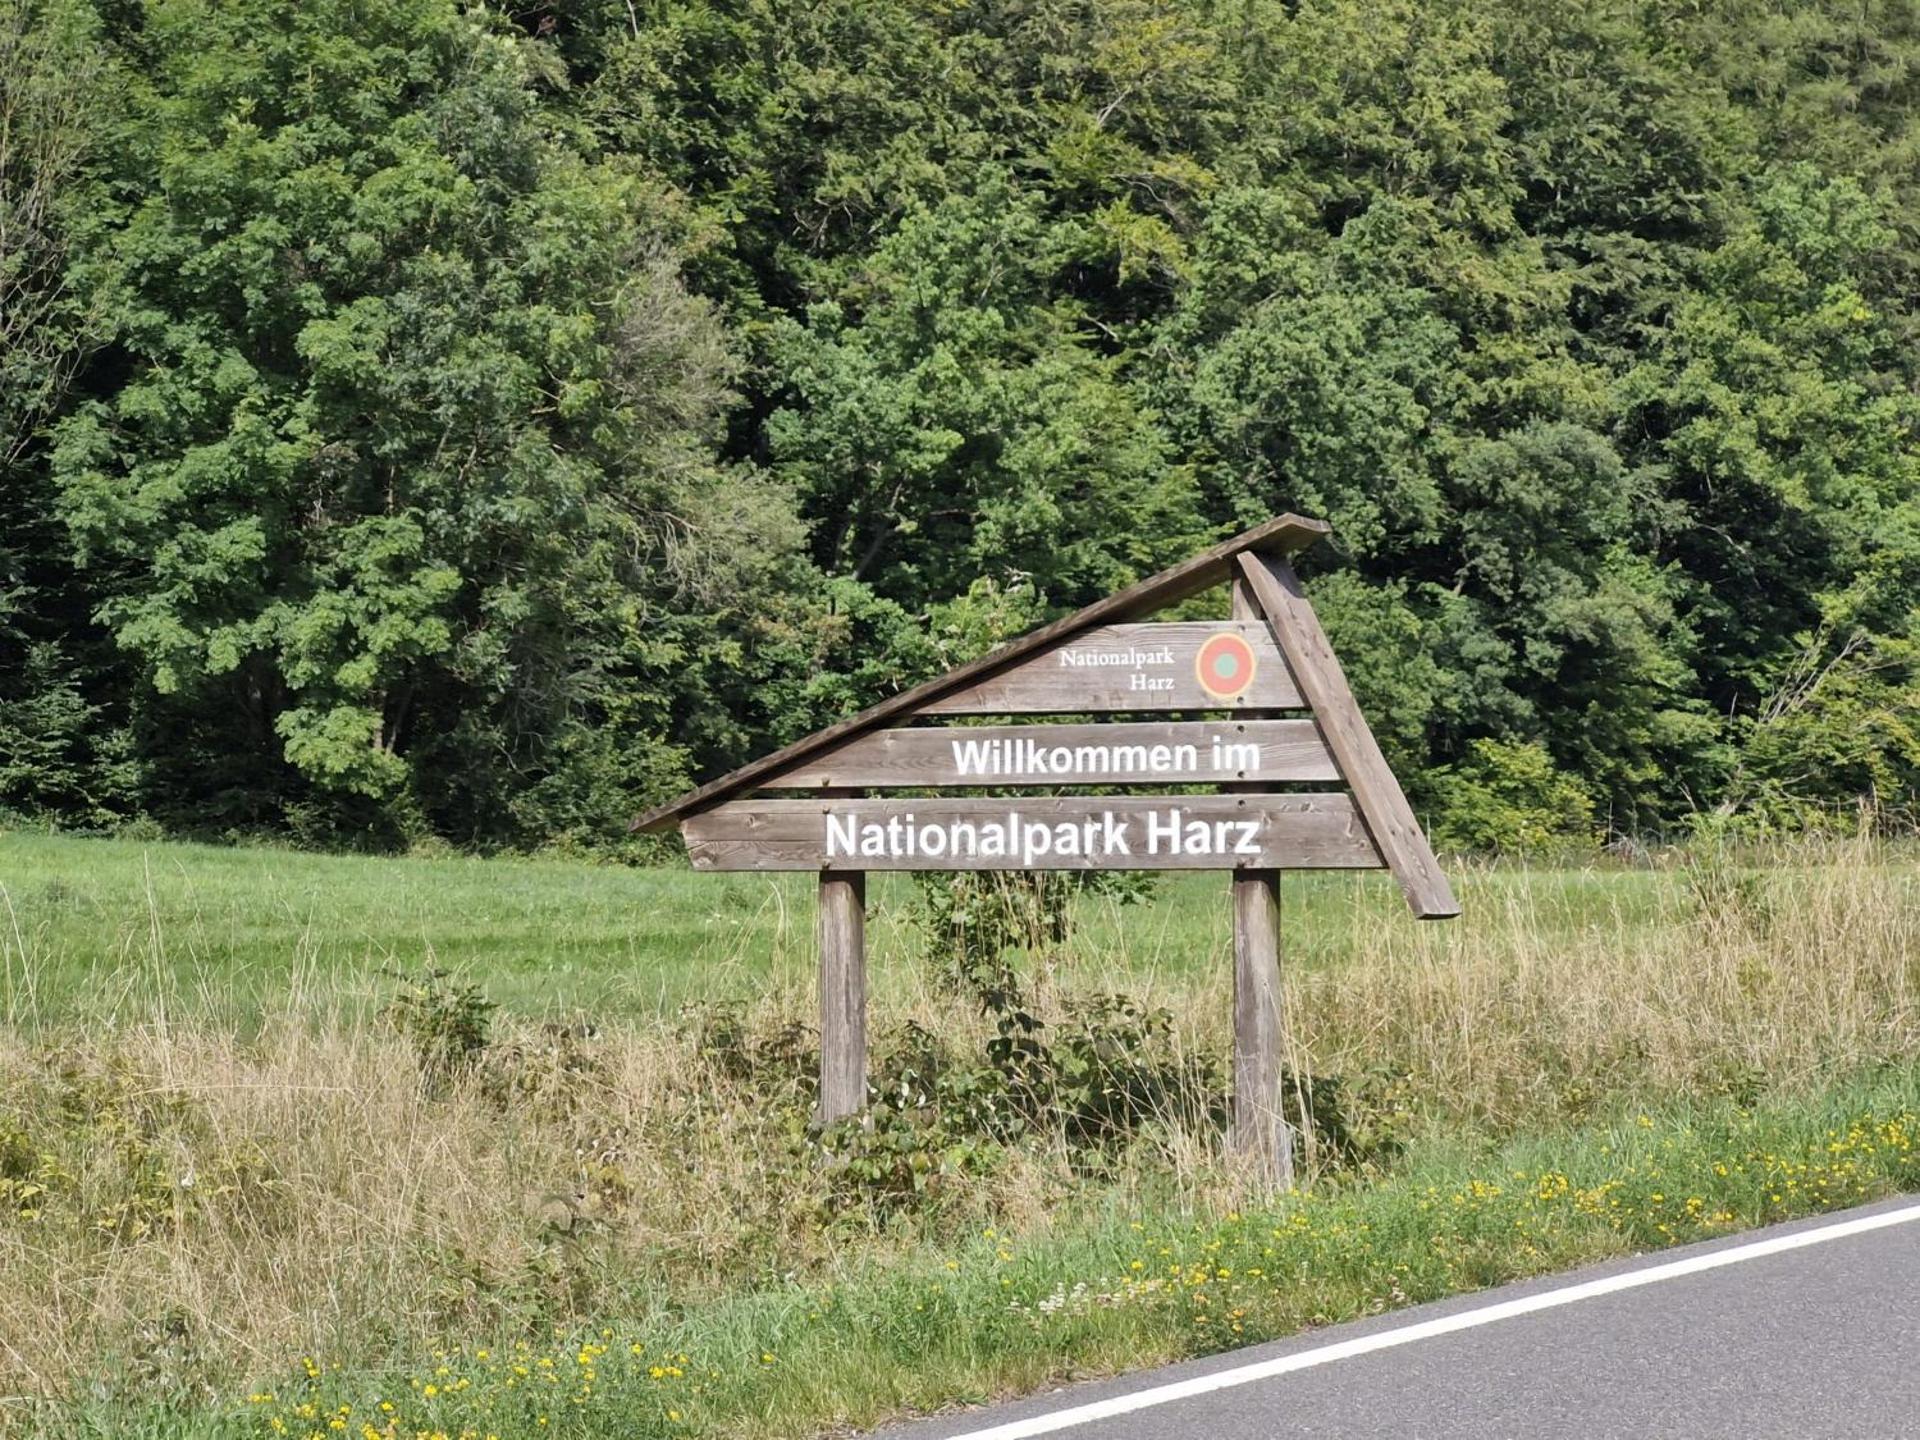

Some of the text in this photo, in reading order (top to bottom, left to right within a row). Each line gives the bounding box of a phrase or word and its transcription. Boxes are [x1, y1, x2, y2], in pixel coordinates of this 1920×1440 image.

[1059, 647, 1175, 669] Nationalpark
[1129, 674, 1175, 691] Harz
[952, 735, 1260, 775] Willkommen im
[826, 809, 1262, 866] Nationalpark Harz
